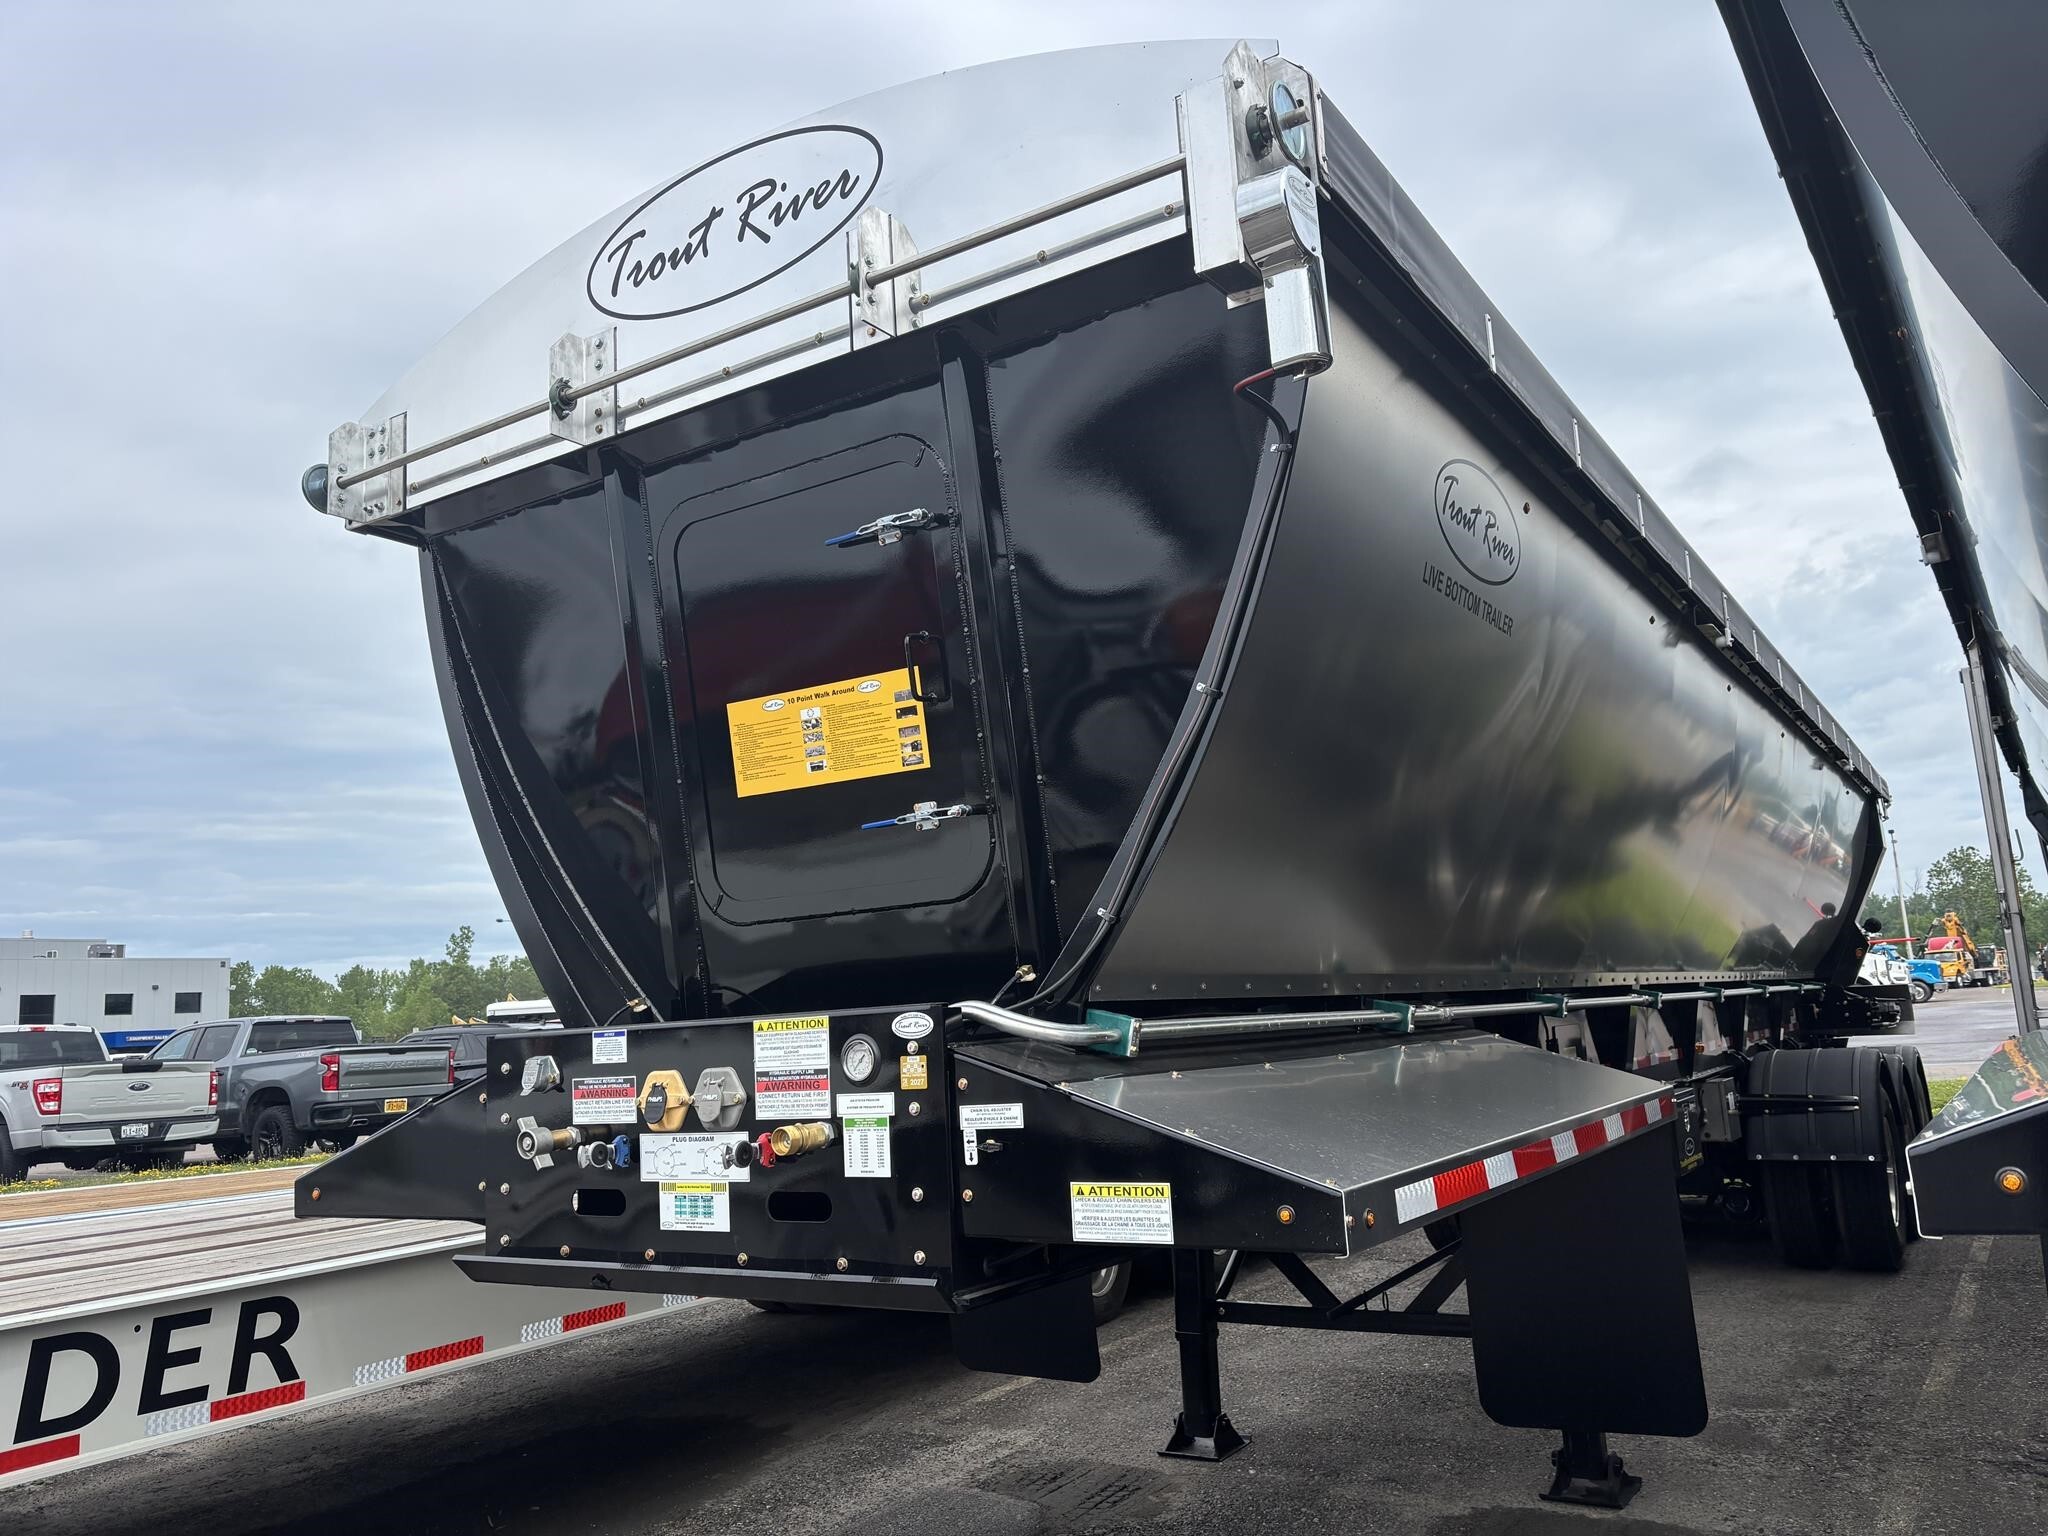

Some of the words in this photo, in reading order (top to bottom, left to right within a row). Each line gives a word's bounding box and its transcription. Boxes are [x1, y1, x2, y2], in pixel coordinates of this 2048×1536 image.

[607, 205, 724, 298] Trout
[736, 168, 860, 244] River
[1443, 475, 1482, 537] Trout
[1483, 510, 1515, 566] River
[1422, 561, 1445, 593] LIVE
[1445, 576, 1481, 617] BOTTOM
[1481, 601, 1514, 637] TRAILER
[787, 697, 795, 705] 10
[796, 694, 813, 703] Point
[814, 690, 830, 700] Walk
[831, 686, 855, 696] Around
[767, 1018, 824, 1031] ATTENTION
[772, 1080, 820, 1091] WARNING
[910, 1078, 924, 1086] 2027
[587, 1088, 628, 1098] WARNING
[1088, 1186, 1165, 1197] ATTENTION
[13, 1296, 301, 1445] DER
